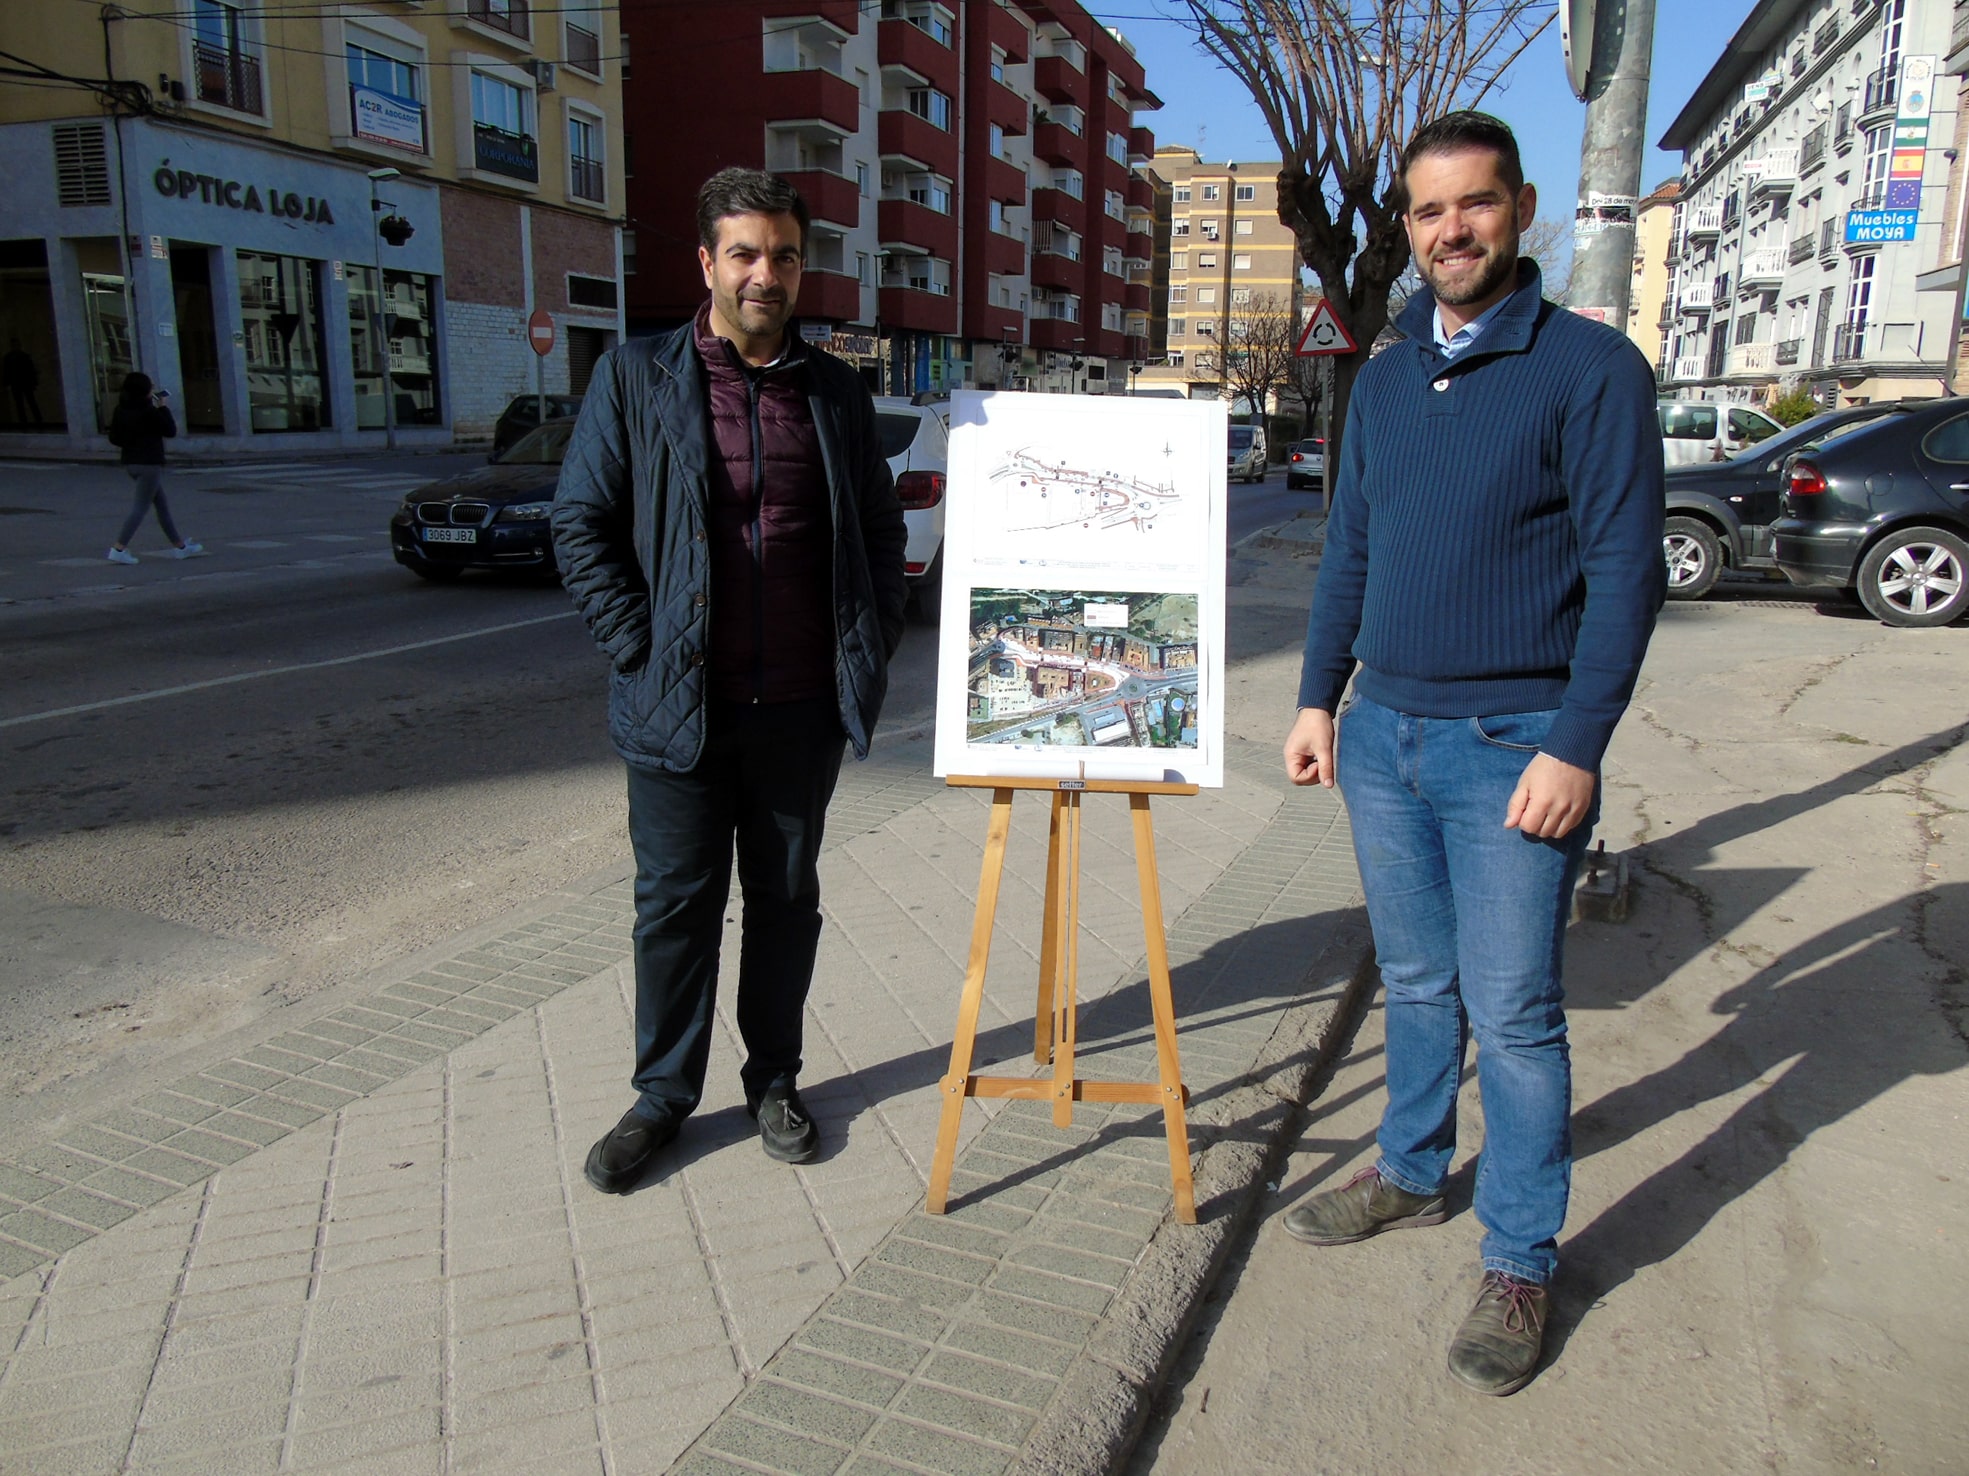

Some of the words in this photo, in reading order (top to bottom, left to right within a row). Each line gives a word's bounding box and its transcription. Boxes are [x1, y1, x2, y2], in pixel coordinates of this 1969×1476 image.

[359, 99, 383, 114] AC2R
[385, 108, 419, 124] ABOGADOS
[155, 158, 265, 213] ÓPTICA
[270, 188, 335, 225] LOJA
[1849, 212, 1914, 227] Muebles
[1855, 226, 1905, 241] MOYA
[428, 529, 451, 541] 3069
[454, 529, 474, 542] JBZ
